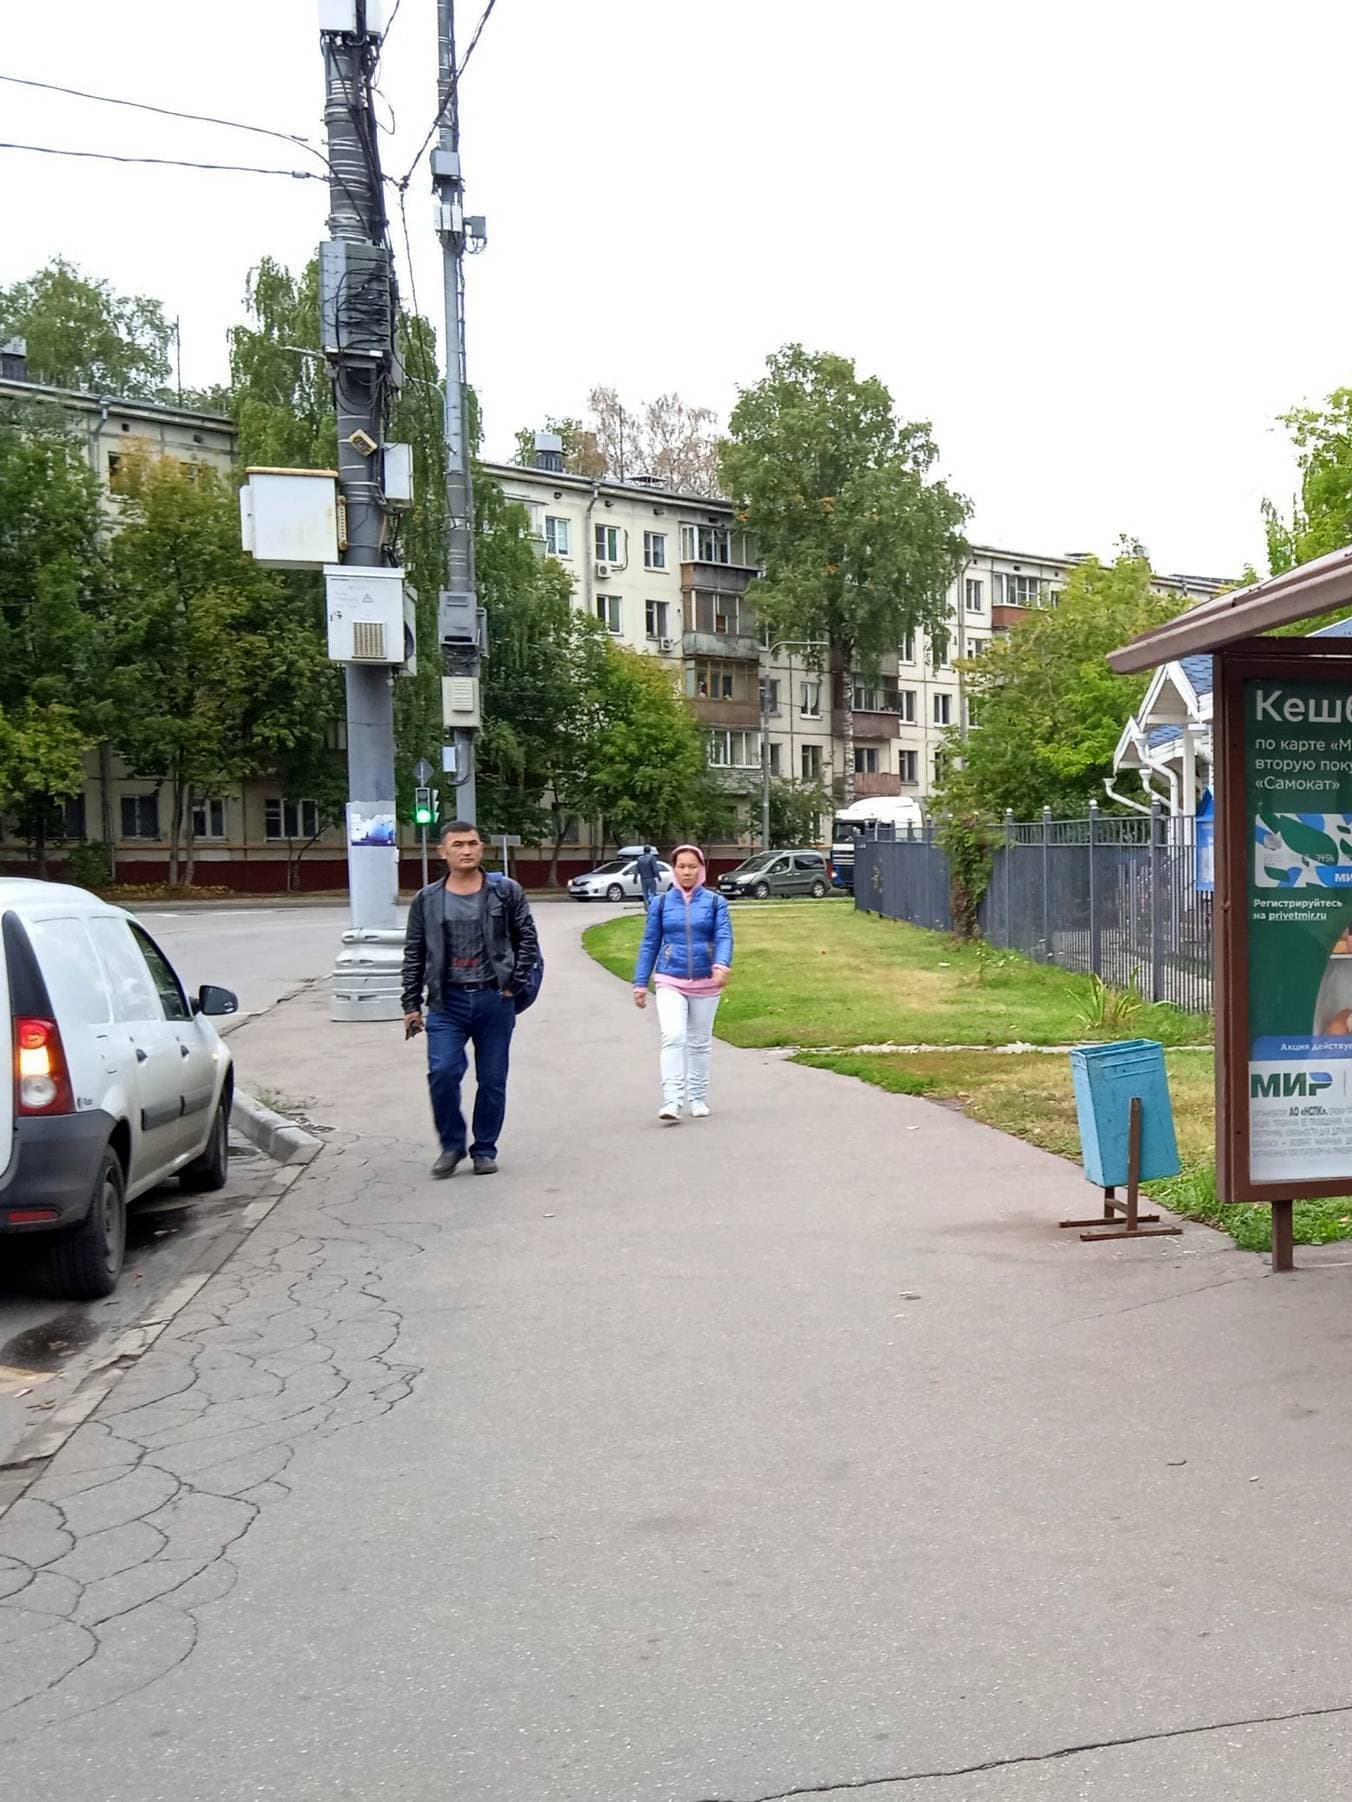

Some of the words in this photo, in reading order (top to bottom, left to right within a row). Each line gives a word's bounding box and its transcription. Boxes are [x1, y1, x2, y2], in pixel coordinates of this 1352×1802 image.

[1255, 740, 1276, 751] по
[1280, 740, 1325, 754] карте
[1255, 760, 1315, 774] вторую
[1255, 776, 1340, 790] «Самокат»
[1253, 899, 1343, 909] Регистрируйтесь
[1269, 911, 1327, 921] privetmir.ru
[1280, 1043, 1310, 1051] Акция
[1250, 1072, 1333, 1098] МИР
